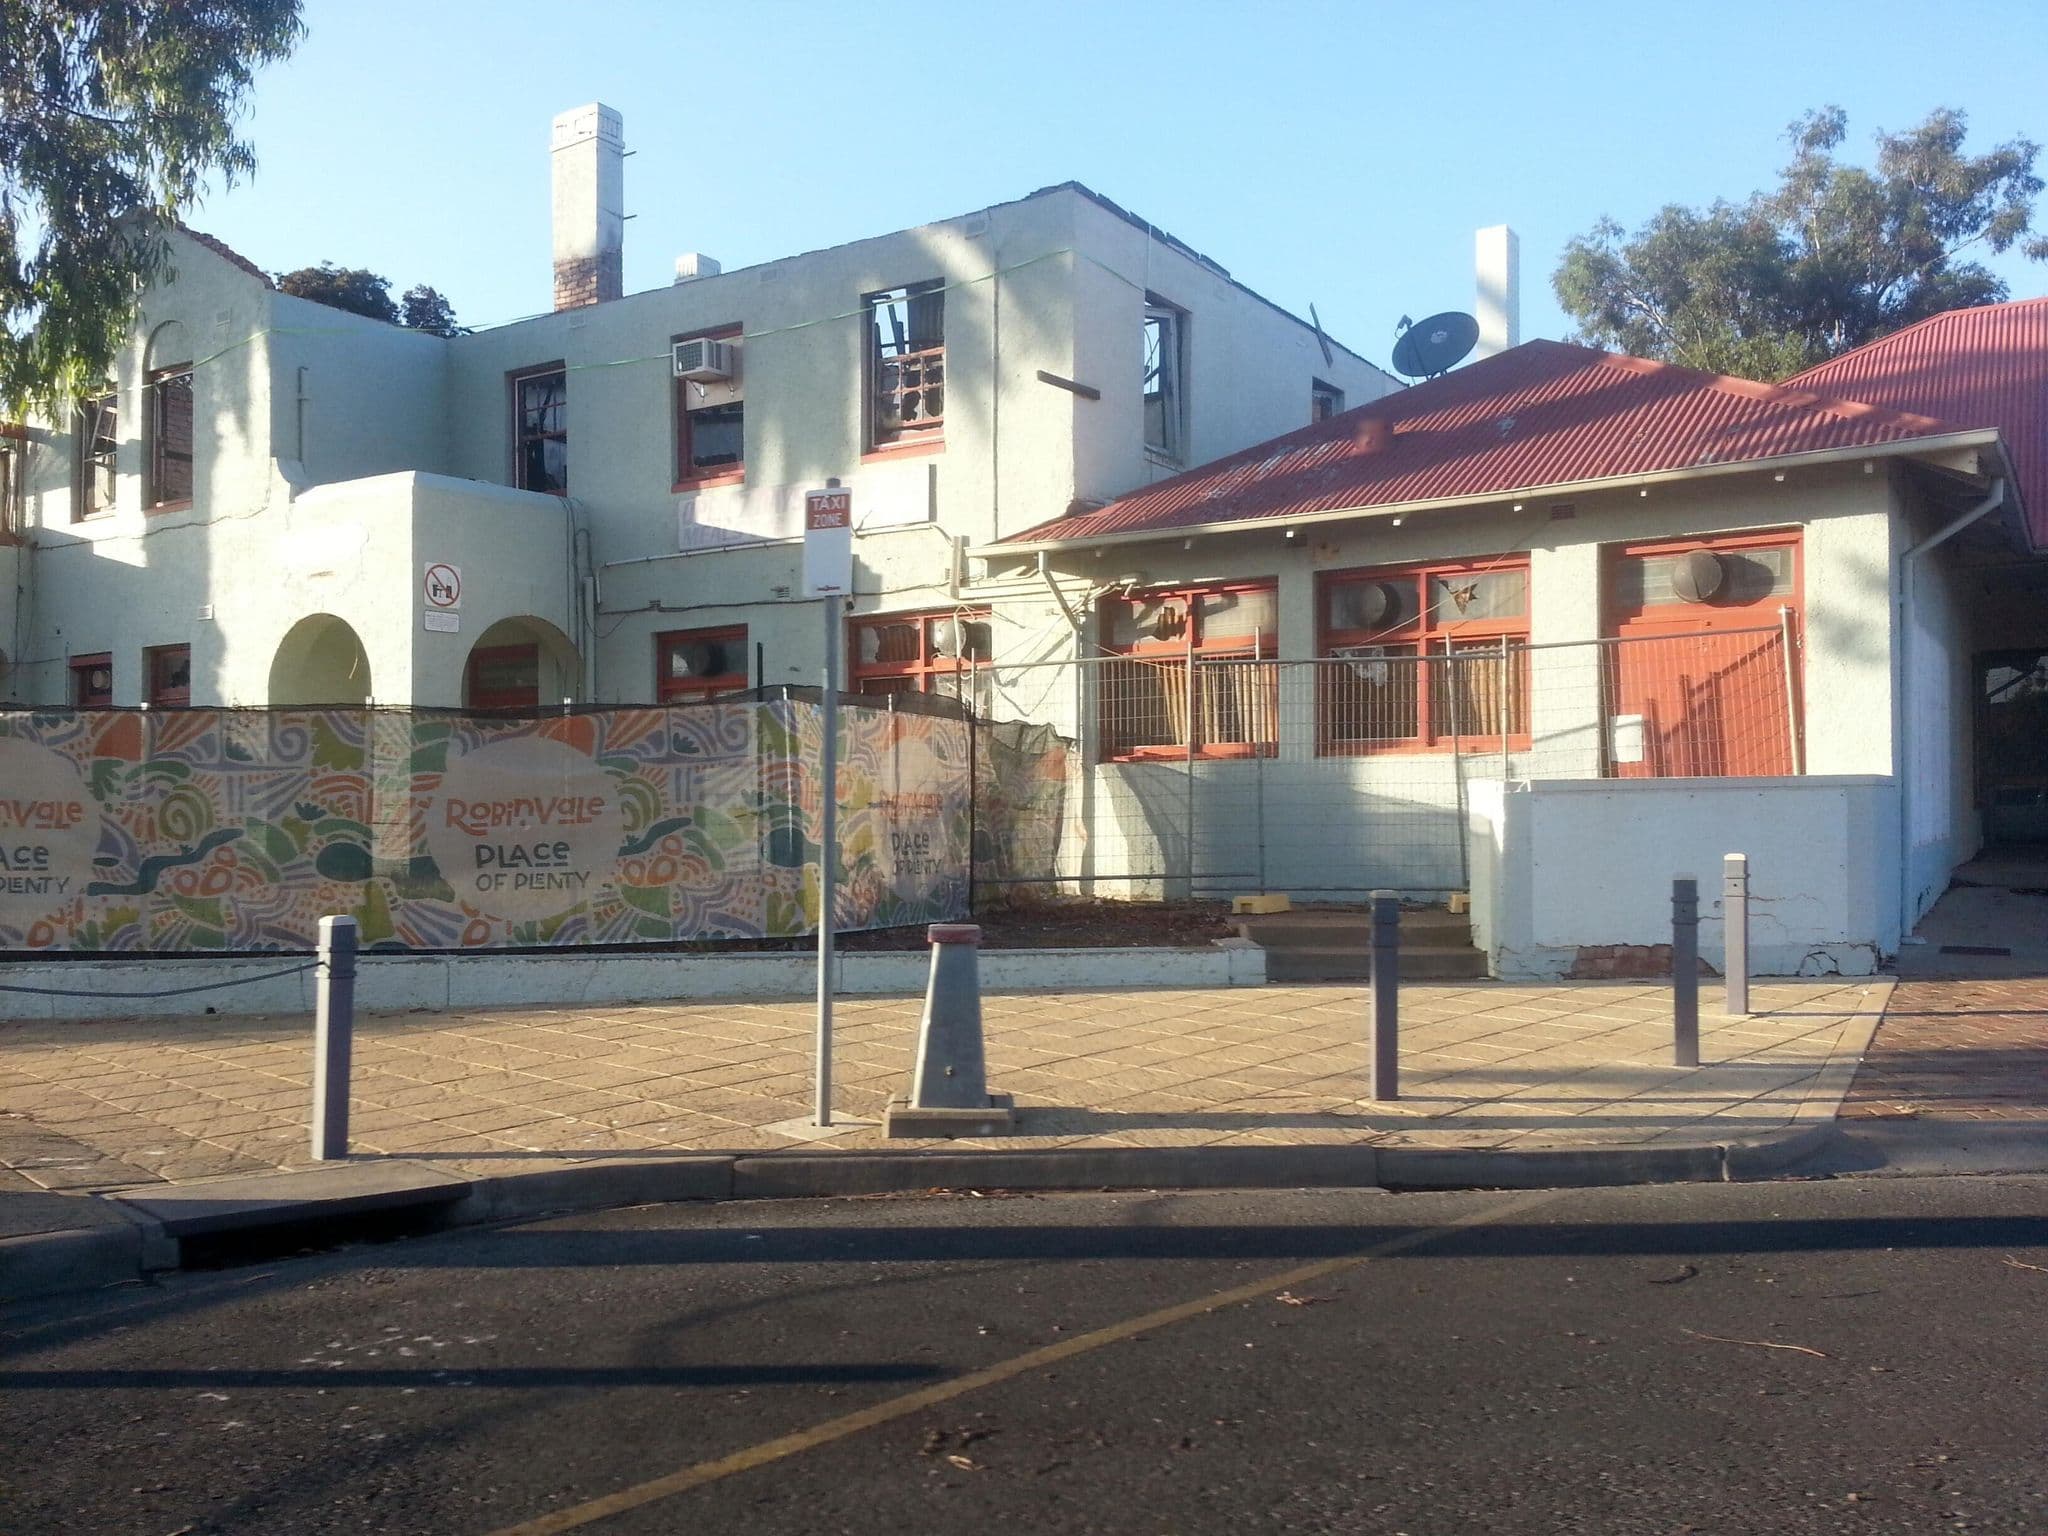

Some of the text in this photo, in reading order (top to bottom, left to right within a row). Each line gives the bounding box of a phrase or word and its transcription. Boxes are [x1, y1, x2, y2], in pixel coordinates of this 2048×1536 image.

[810, 495, 846, 511] TAXI
[813, 512, 843, 528] ZONE
[476, 871, 590, 891] OF PLENTY
